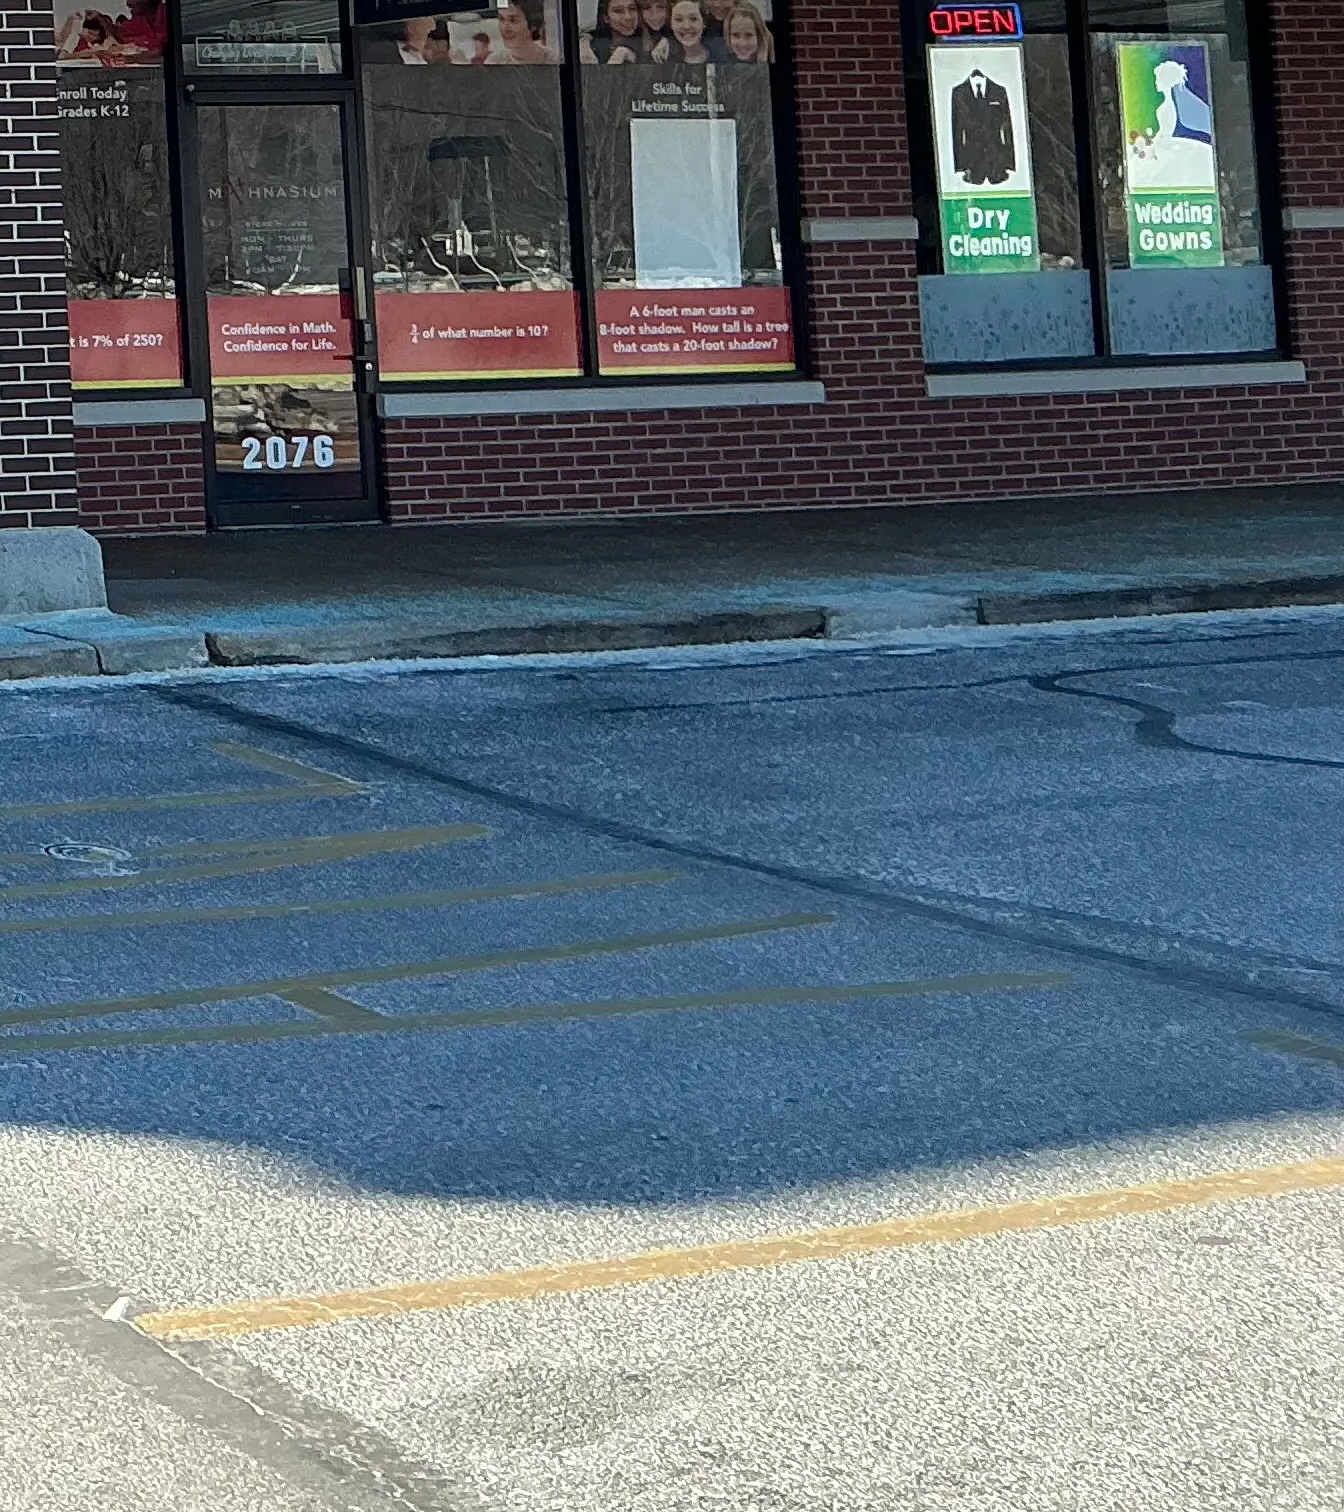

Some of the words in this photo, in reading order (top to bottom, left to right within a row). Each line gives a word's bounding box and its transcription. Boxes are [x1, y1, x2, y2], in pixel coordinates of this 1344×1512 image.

[929, 9, 1015, 34] OPEN
[58, 86, 87, 100] nroll
[90, 86, 128, 103] Today
[652, 82, 683, 95] Skills
[685, 81, 703, 95] for
[100, 104, 130, 118] K-12
[631, 99, 679, 113] Lifetime
[967, 207, 1011, 230] Dry
[1134, 202, 1213, 225] Wedding
[948, 232, 1033, 257] Cleaning
[1139, 228, 1213, 251] Gowns
[629, 305, 641, 318] A
[641, 304, 679, 318] 6-foot
[680, 306, 706, 317] man
[708, 304, 738, 316] casts
[740, 305, 755, 316] an
[221, 322, 286, 336] Confidence
[289, 322, 301, 334] in
[302, 321, 337, 334] Math.
[422, 326, 435, 339] of
[437, 325, 468, 339] what
[469, 325, 514, 338] number
[515, 325, 526, 337] is
[527, 324, 549, 337] 10?
[599, 322, 636, 336] 8-foot
[638, 322, 686, 336] shadow.
[691, 321, 719, 334] How
[721, 319, 741, 333] tall
[743, 319, 753, 333] is
[755, 323, 763, 333] a
[765, 321, 789, 333] tree
[78, 336, 89, 348] is
[92, 334, 113, 348] 7%
[115, 334, 131, 347] of
[132, 333, 163, 347] 250?
[223, 340, 289, 353] Confidence
[292, 338, 309, 351] for
[311, 337, 337, 351] Life.
[613, 340, 638, 353] that
[641, 340, 670, 353] casts
[672, 342, 681, 352] a
[683, 338, 726, 352] 20-foot
[728, 337, 779, 351] shadow?
[241, 434, 335, 470] 2076
